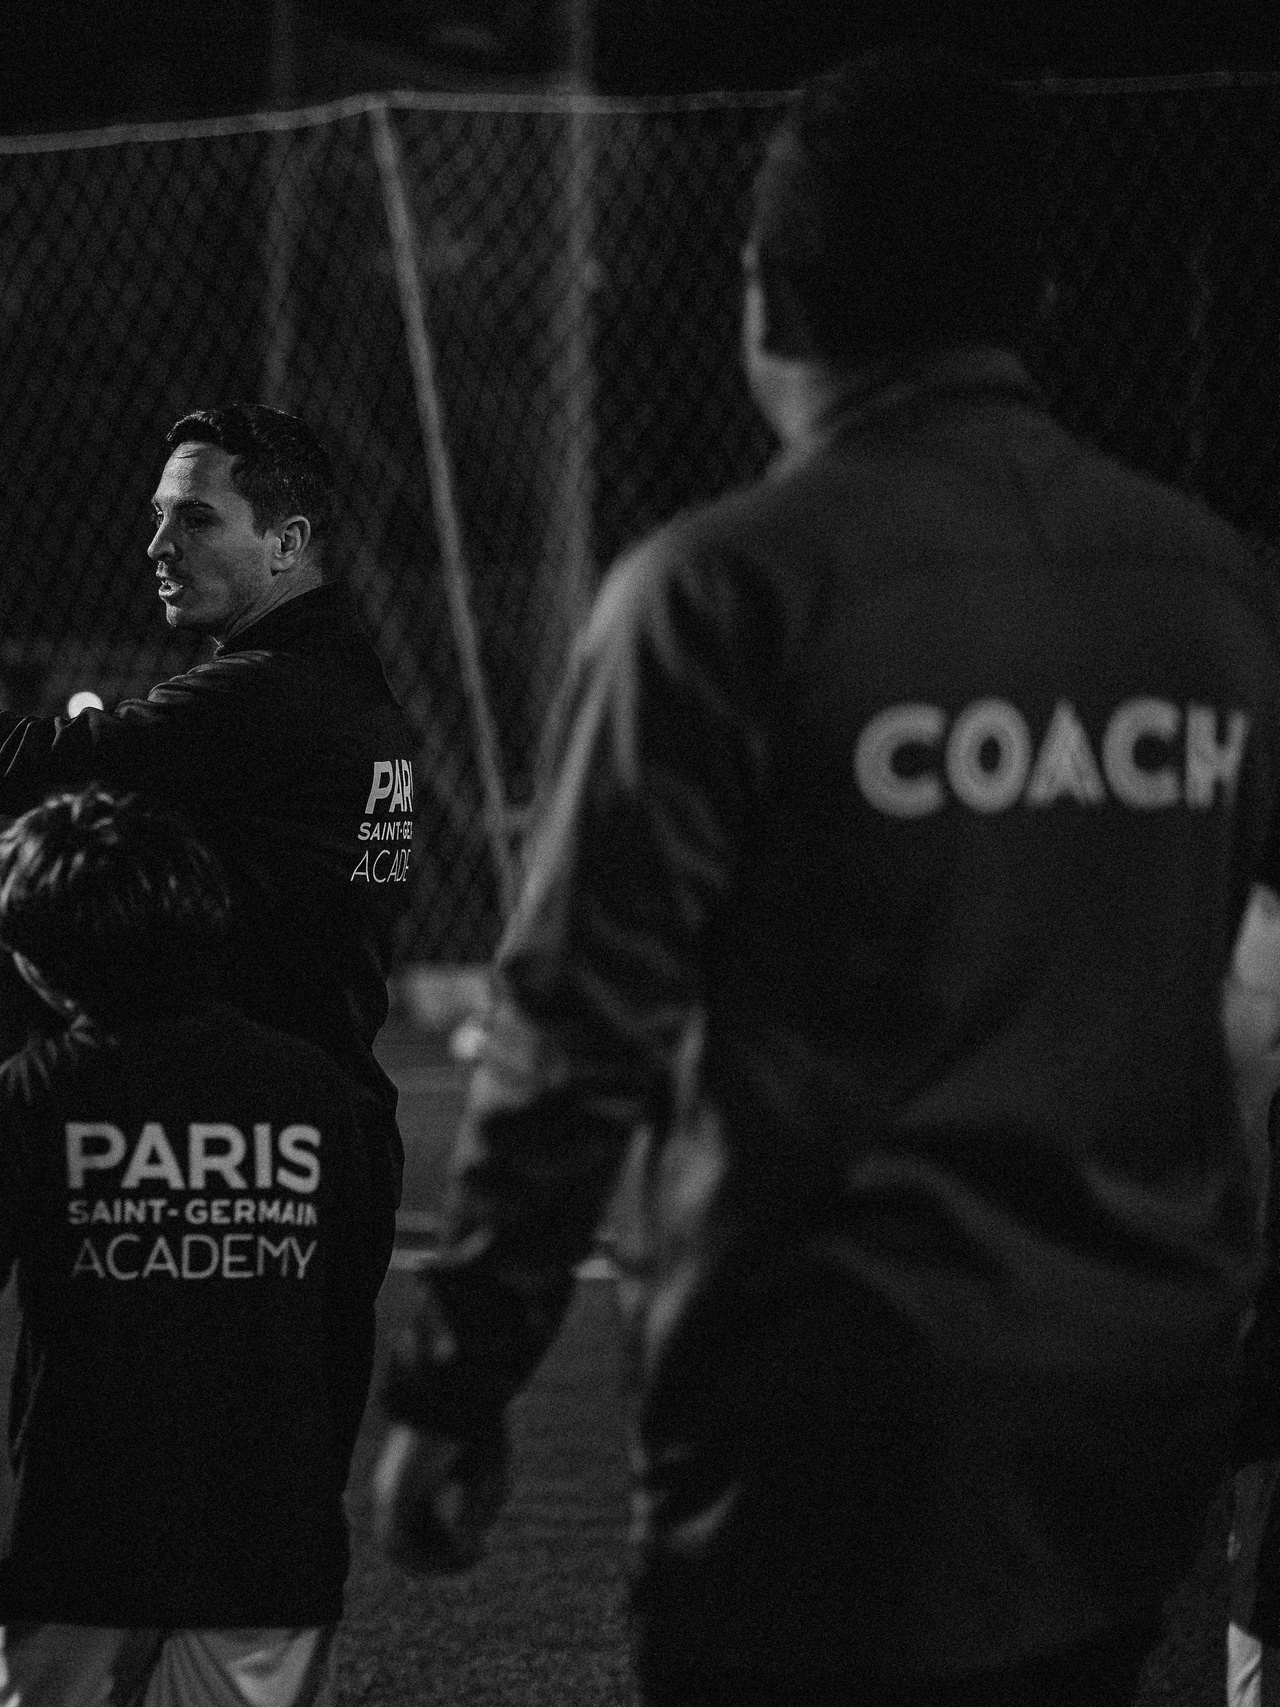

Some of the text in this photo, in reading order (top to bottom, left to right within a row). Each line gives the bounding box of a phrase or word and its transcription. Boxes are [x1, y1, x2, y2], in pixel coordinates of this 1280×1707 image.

[854, 696, 1250, 819] COACH
[65, 1121, 322, 1194] PARIS
[67, 1198, 319, 1227] SAINT-GERMAIN
[70, 1233, 319, 1281] ACADEMY
